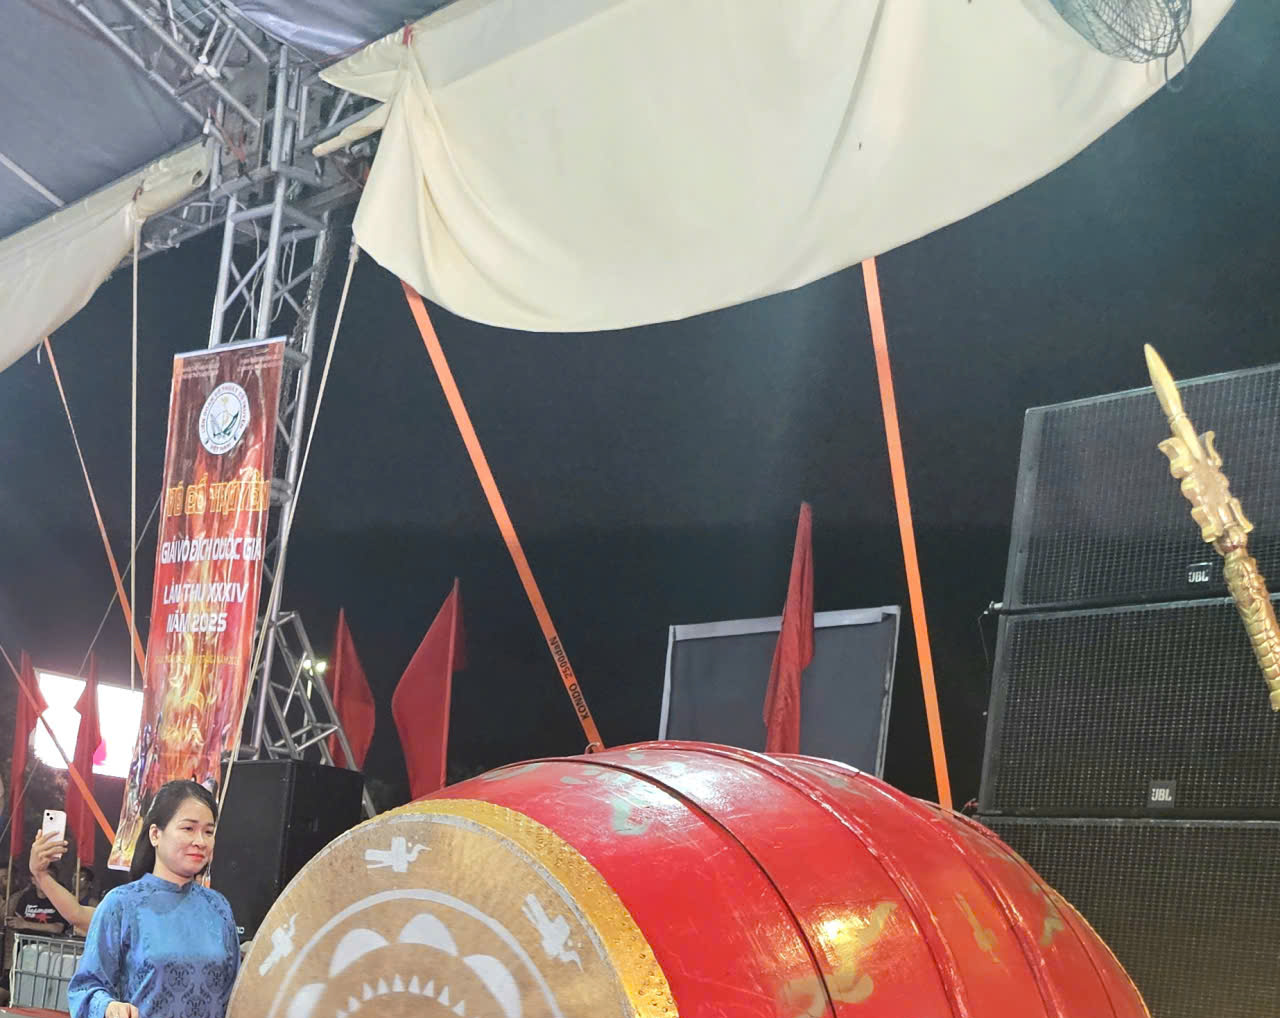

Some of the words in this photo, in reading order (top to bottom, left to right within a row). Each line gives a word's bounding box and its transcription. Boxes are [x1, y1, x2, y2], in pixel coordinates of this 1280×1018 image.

[1188, 570, 1209, 583] JBL
[206, 582, 249, 603] XXXIV
[191, 612, 228, 633] 2025
[549, 635, 573, 680] 2500daN
[568, 682, 590, 721] KONDO
[1151, 788, 1172, 801] JBL
